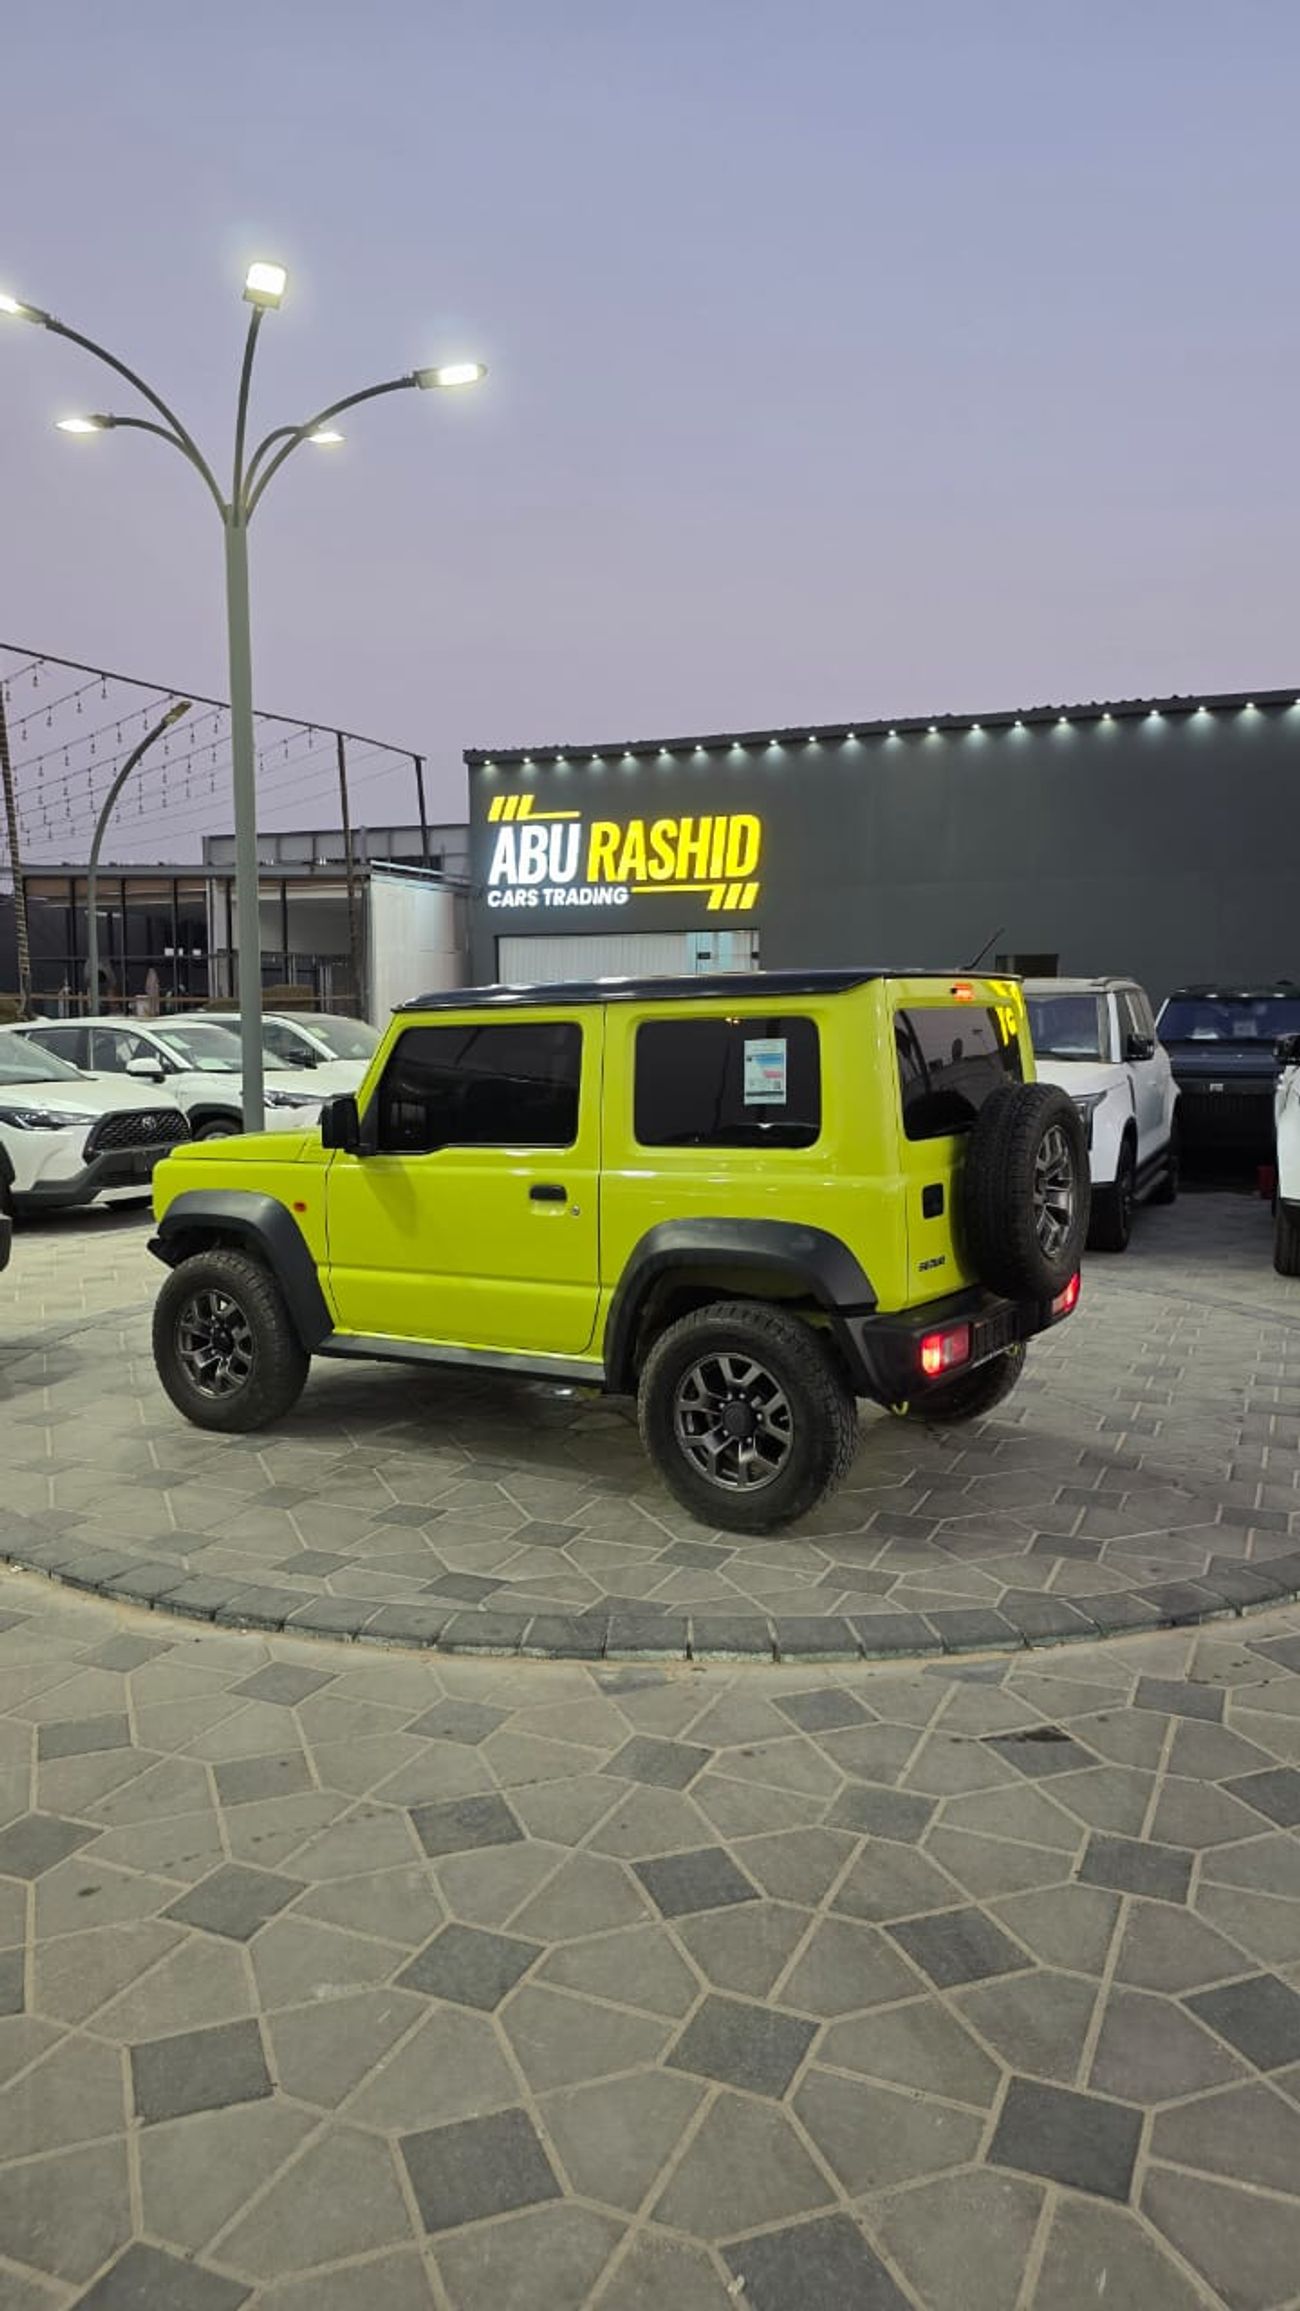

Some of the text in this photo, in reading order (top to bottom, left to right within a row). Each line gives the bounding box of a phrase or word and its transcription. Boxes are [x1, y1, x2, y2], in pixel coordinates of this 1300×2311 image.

[488, 814, 761, 886] ABU RASHID
[487, 886, 629, 908] CARS TRADING
